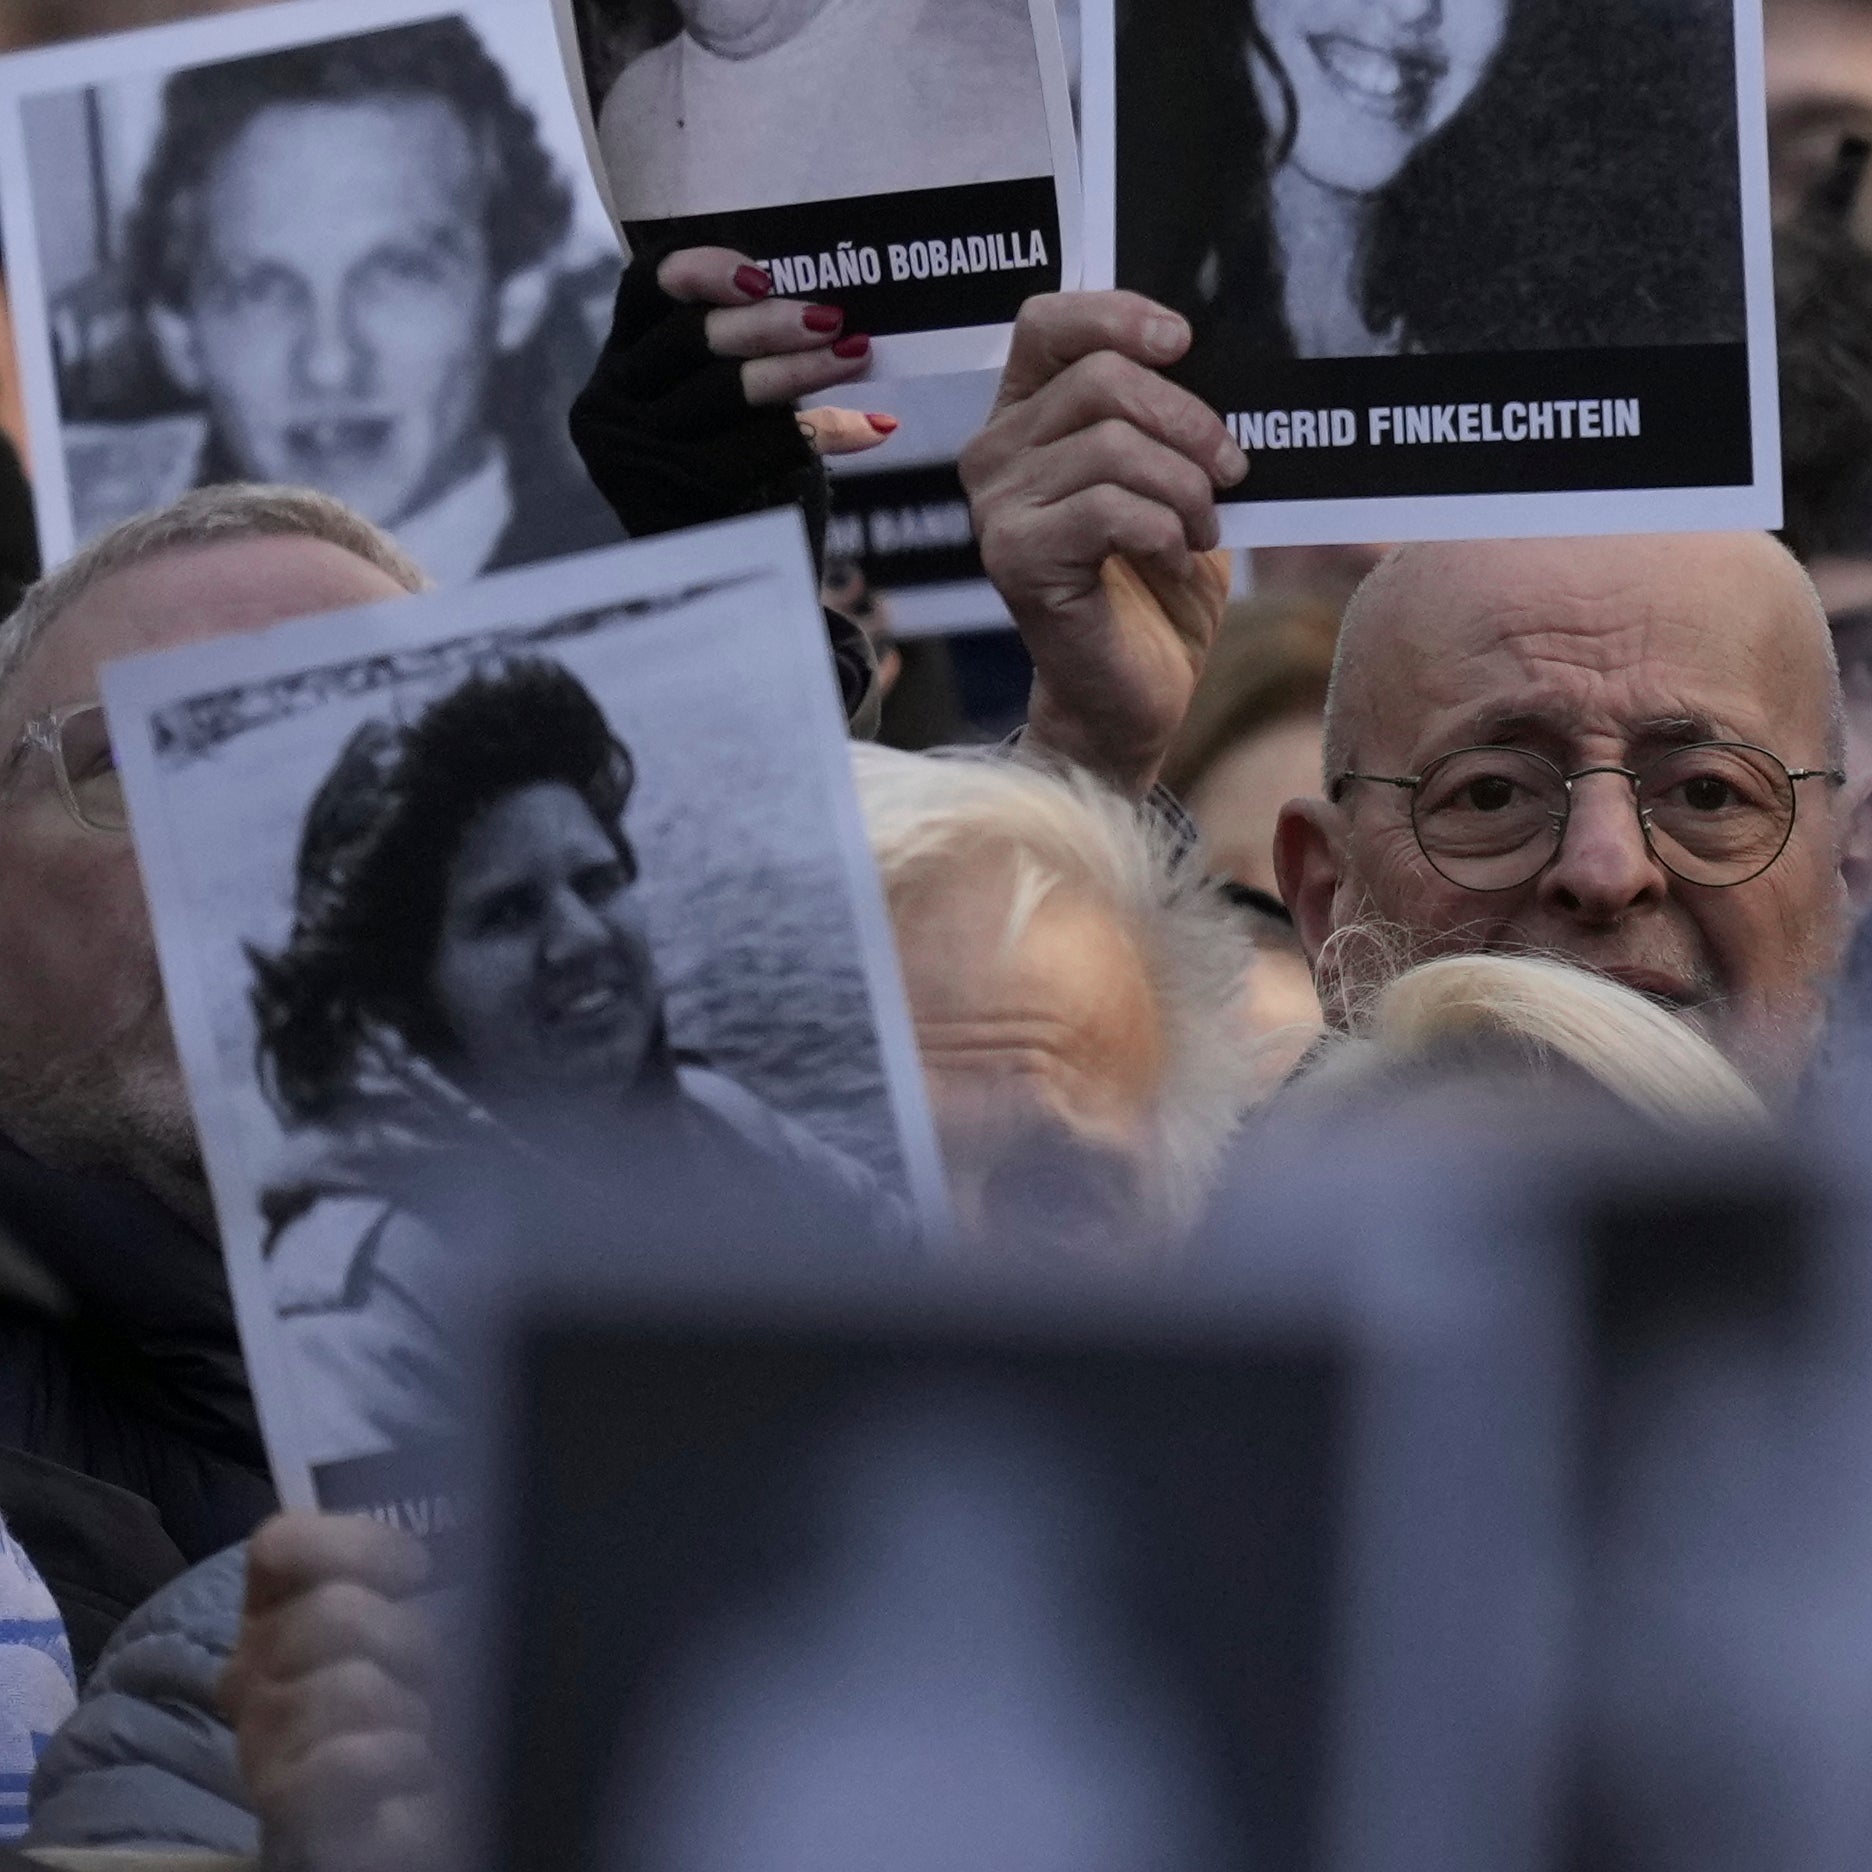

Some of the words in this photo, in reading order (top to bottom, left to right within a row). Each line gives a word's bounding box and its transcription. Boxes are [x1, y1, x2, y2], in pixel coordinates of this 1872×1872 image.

[888, 230, 1048, 280] BOBADILLA
[1226, 409, 1357, 450] INGRID
[1369, 399, 1641, 445] FINKELCHTEIN
